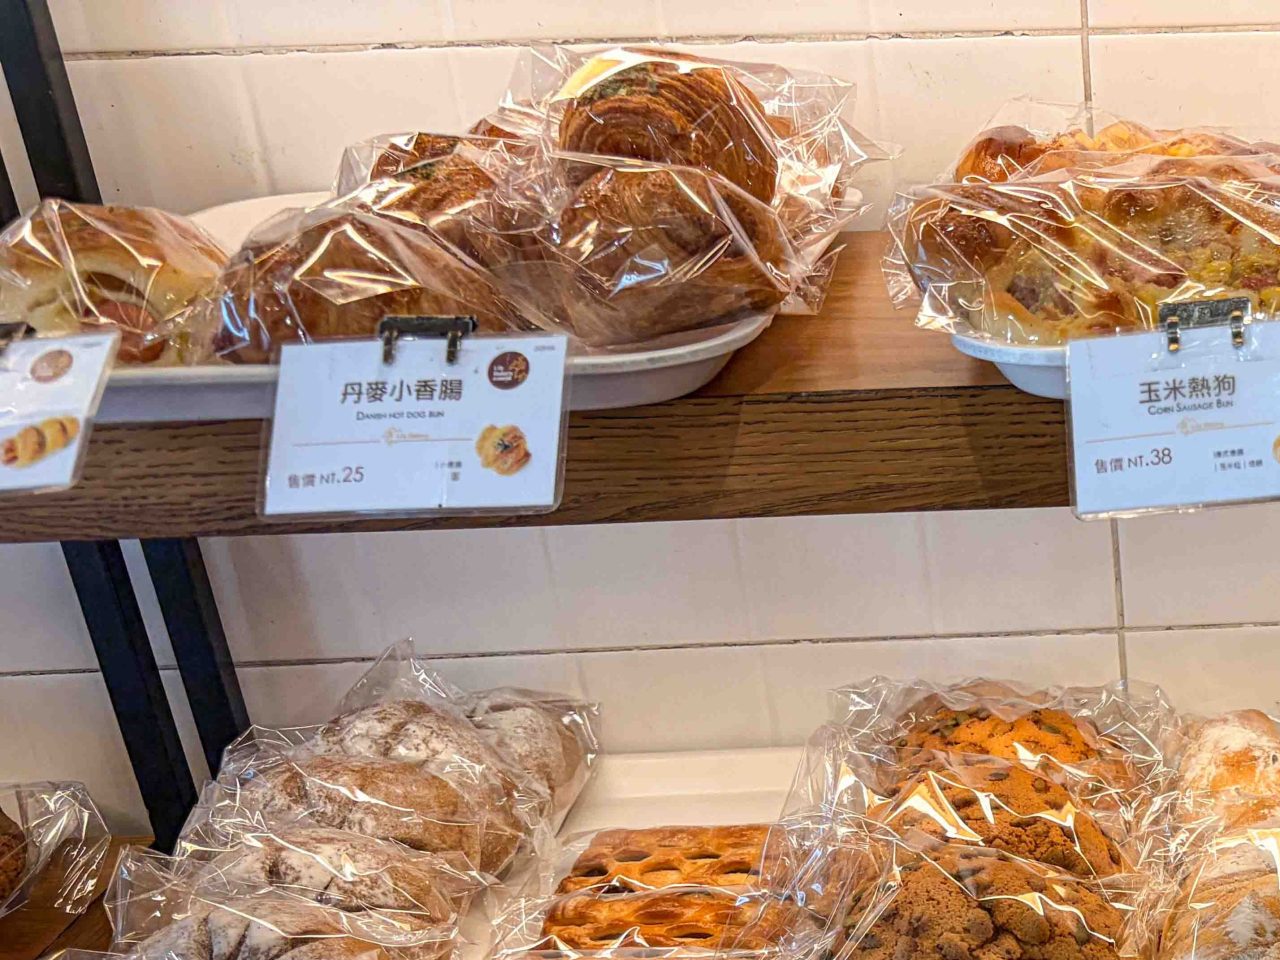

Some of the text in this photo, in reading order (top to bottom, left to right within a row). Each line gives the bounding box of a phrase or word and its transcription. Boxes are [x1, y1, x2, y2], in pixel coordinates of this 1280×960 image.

[341, 379, 462, 405] 丹麥小香腸
[1139, 374, 1236, 404] 玉米熱狗
[1094, 447, 1172, 474] 售價 NT.38
[288, 466, 364, 488] 售價 NT.25
